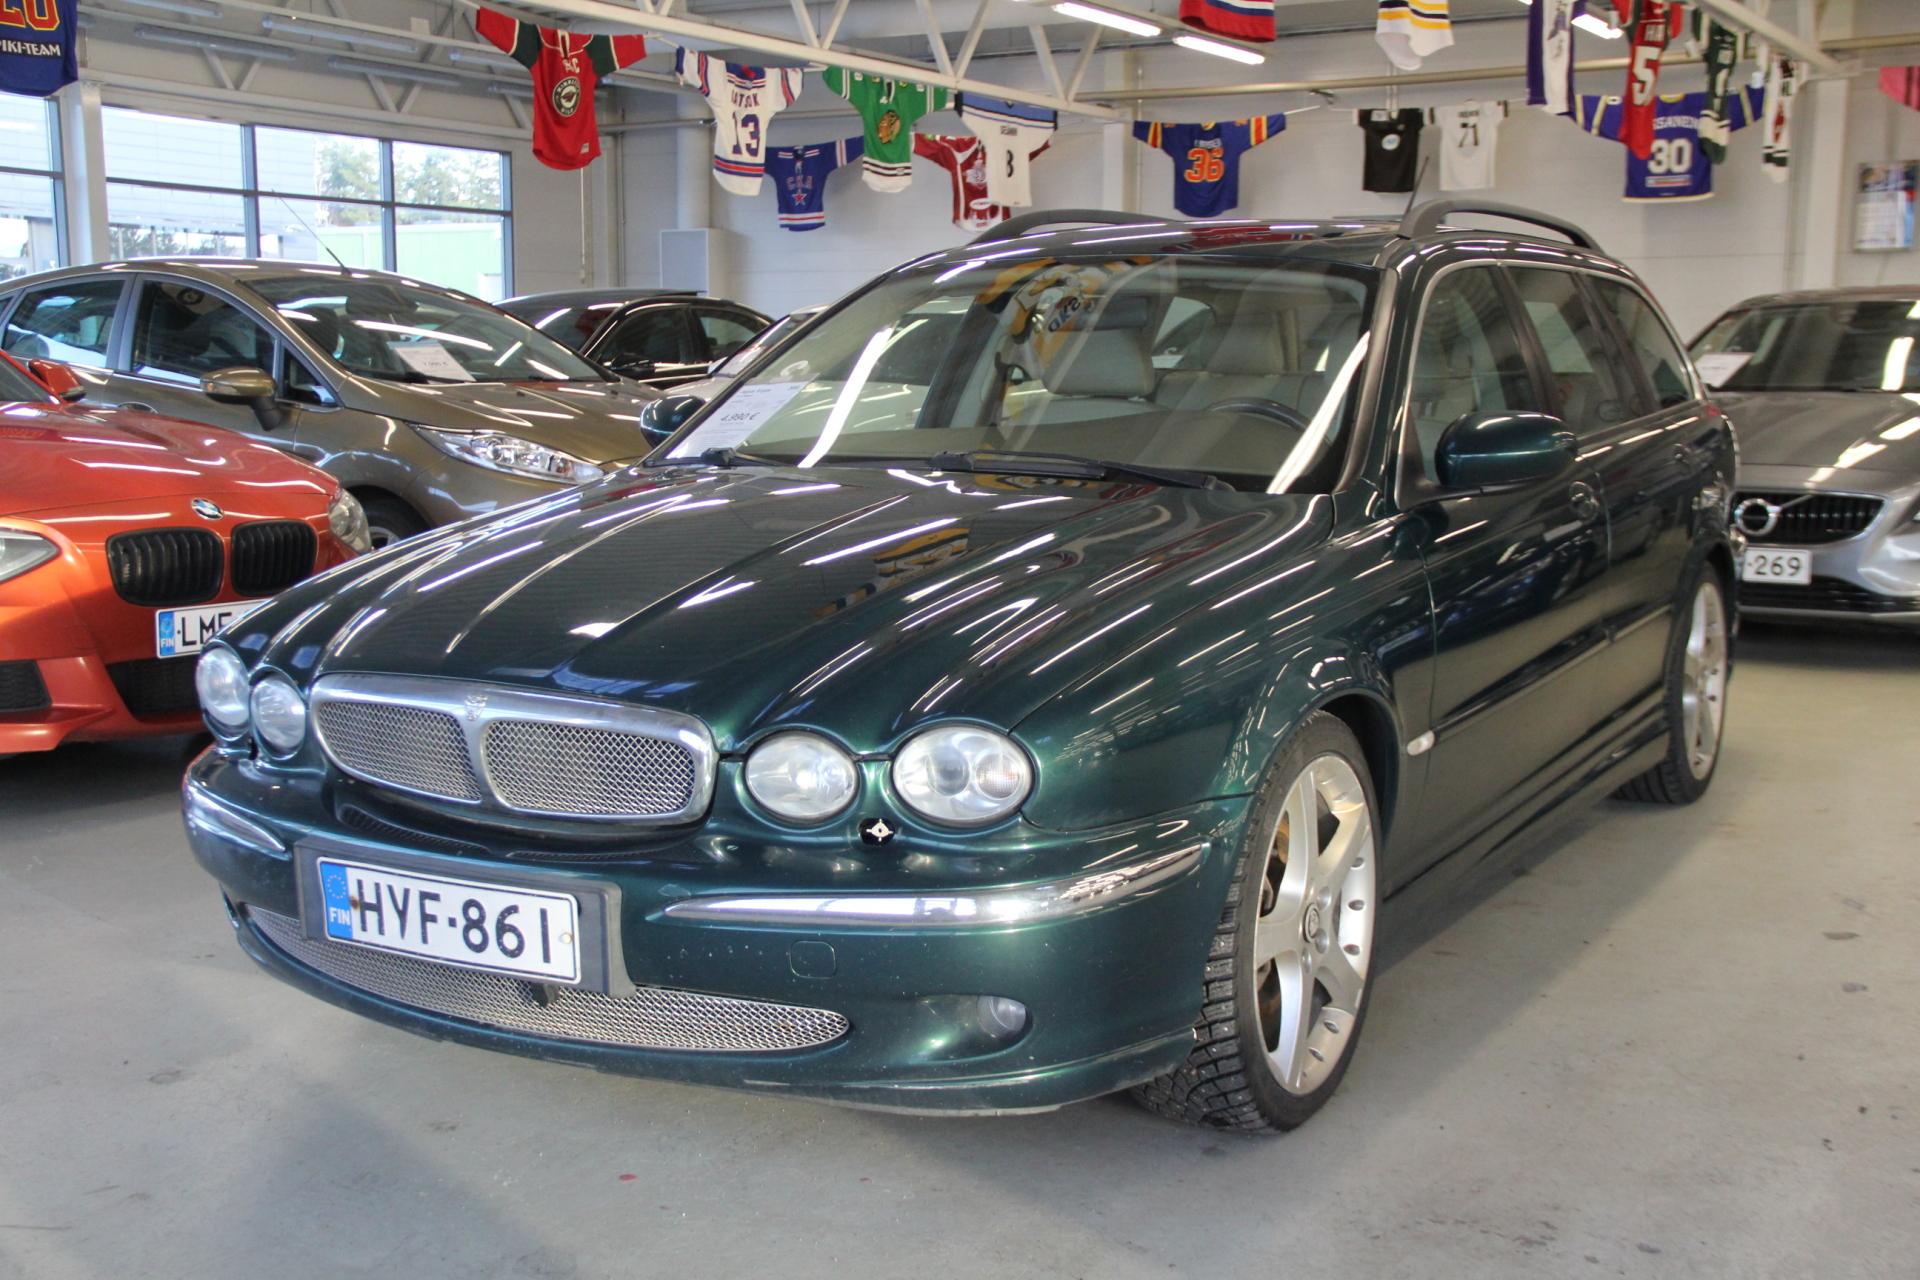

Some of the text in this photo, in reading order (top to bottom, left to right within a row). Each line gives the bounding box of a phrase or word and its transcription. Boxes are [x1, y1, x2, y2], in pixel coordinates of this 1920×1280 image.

[0, 39, 61, 56] IKI-TEAM
[732, 111, 760, 157] 13
[1184, 147, 1225, 183] 36
[1648, 138, 1692, 174] 30
[329, 906, 351, 926] FIN
[356, 878, 551, 964] HYF-861
